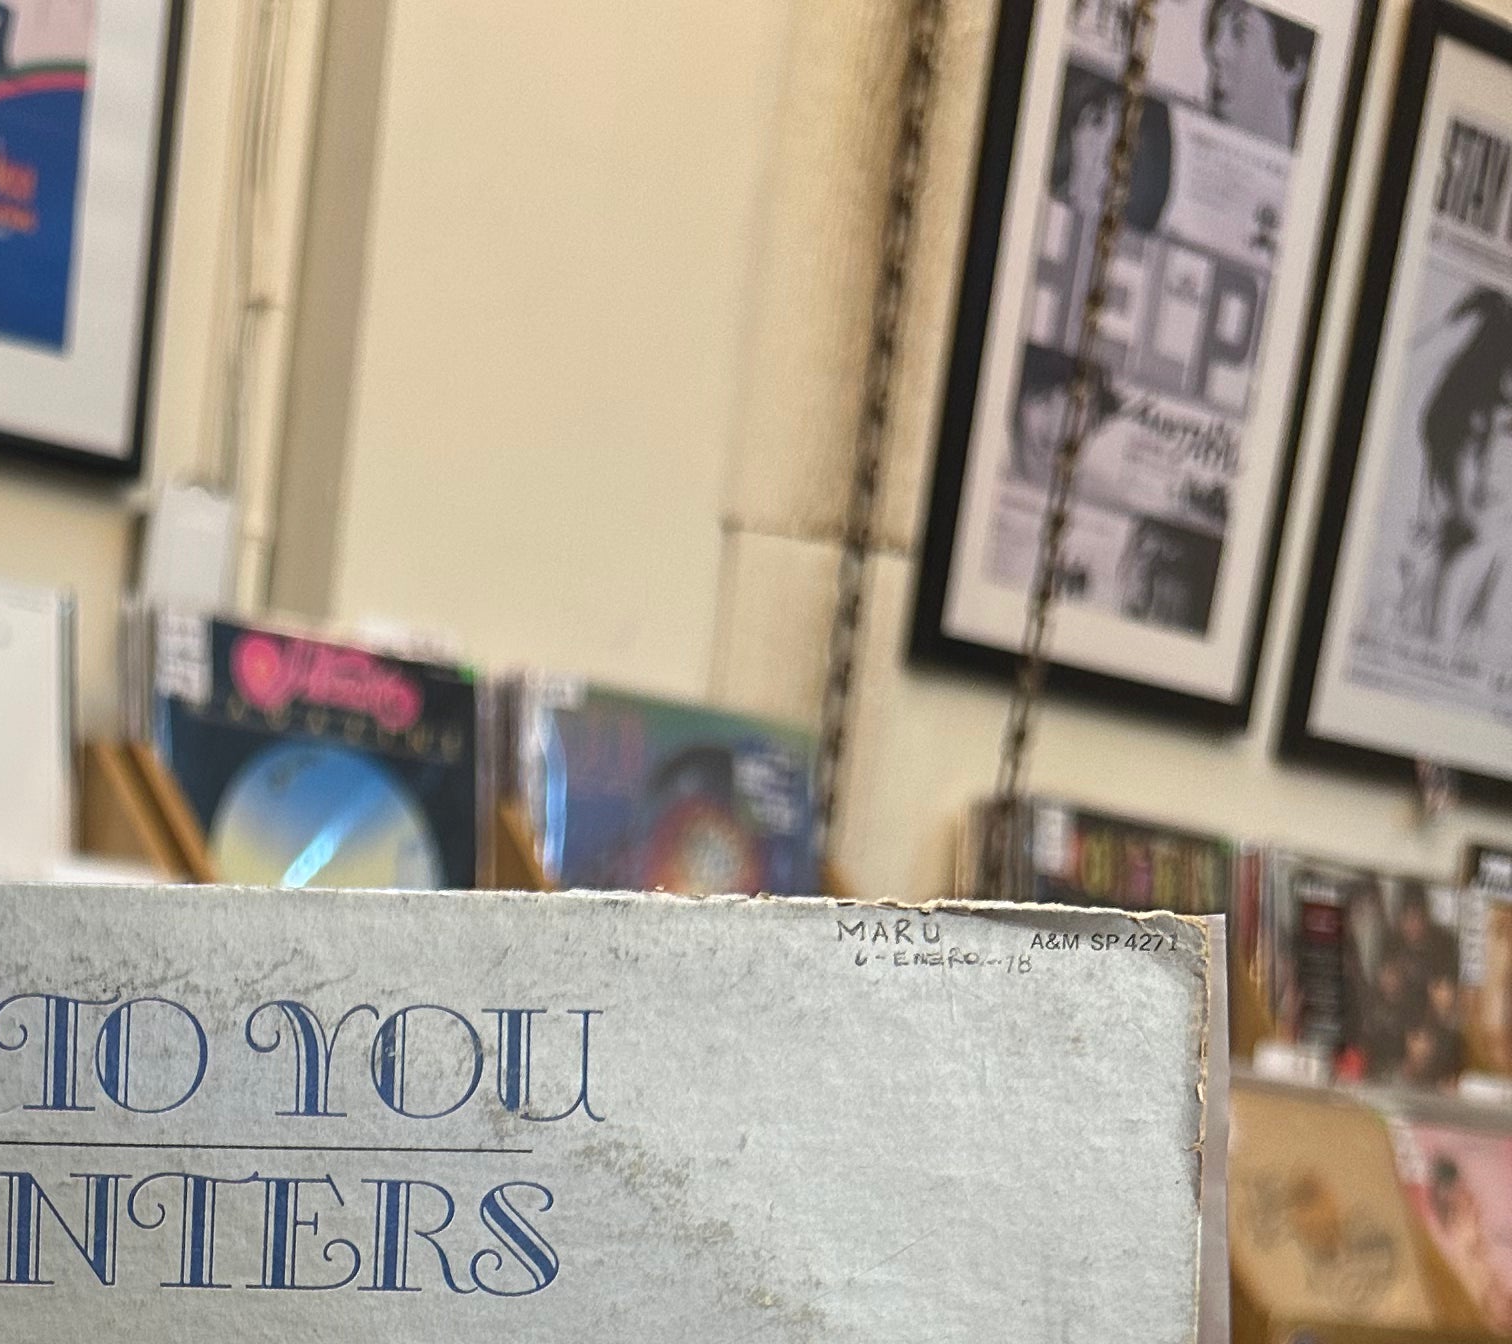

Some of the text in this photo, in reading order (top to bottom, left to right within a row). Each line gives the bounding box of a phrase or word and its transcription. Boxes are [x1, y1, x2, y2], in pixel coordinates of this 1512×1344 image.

[836, 918, 941, 945] MARU
[1030, 933, 1180, 952] A&M SP 4271
[245, 999, 606, 1123] YOU
